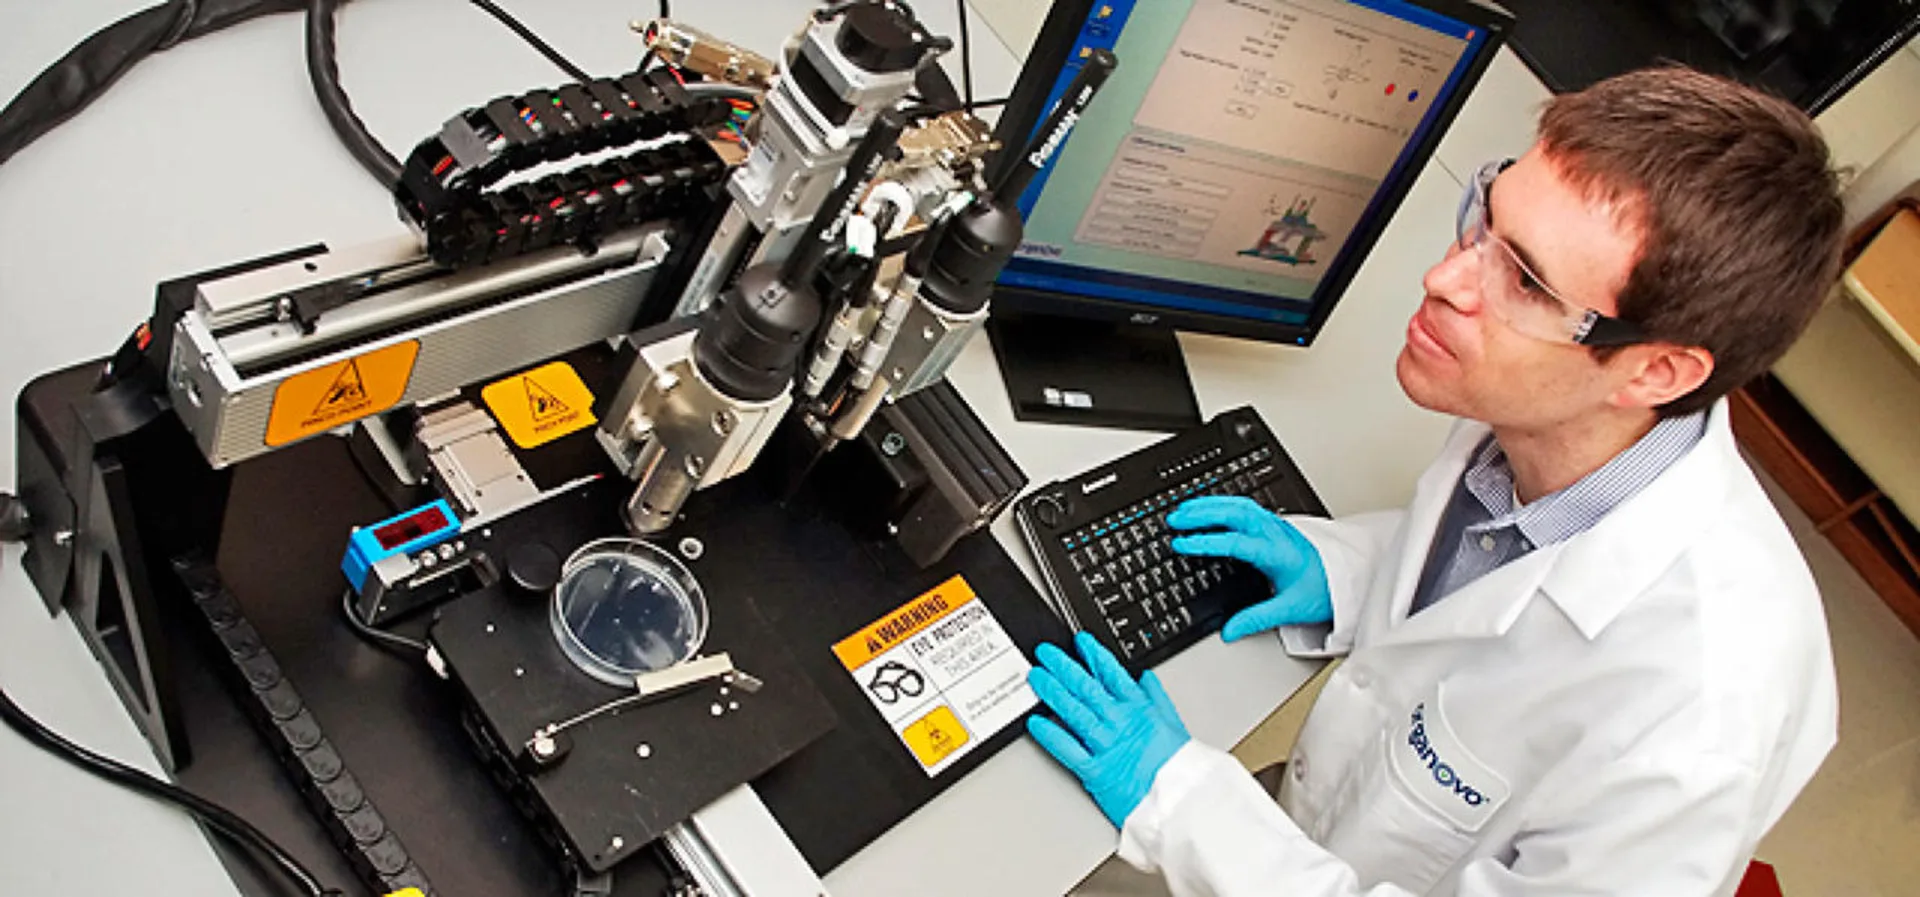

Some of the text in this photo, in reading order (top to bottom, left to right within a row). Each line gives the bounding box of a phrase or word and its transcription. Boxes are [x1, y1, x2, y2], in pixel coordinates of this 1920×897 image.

[876, 594, 949, 644] WARNING
[911, 605, 988, 656] EYE PROTECTION
